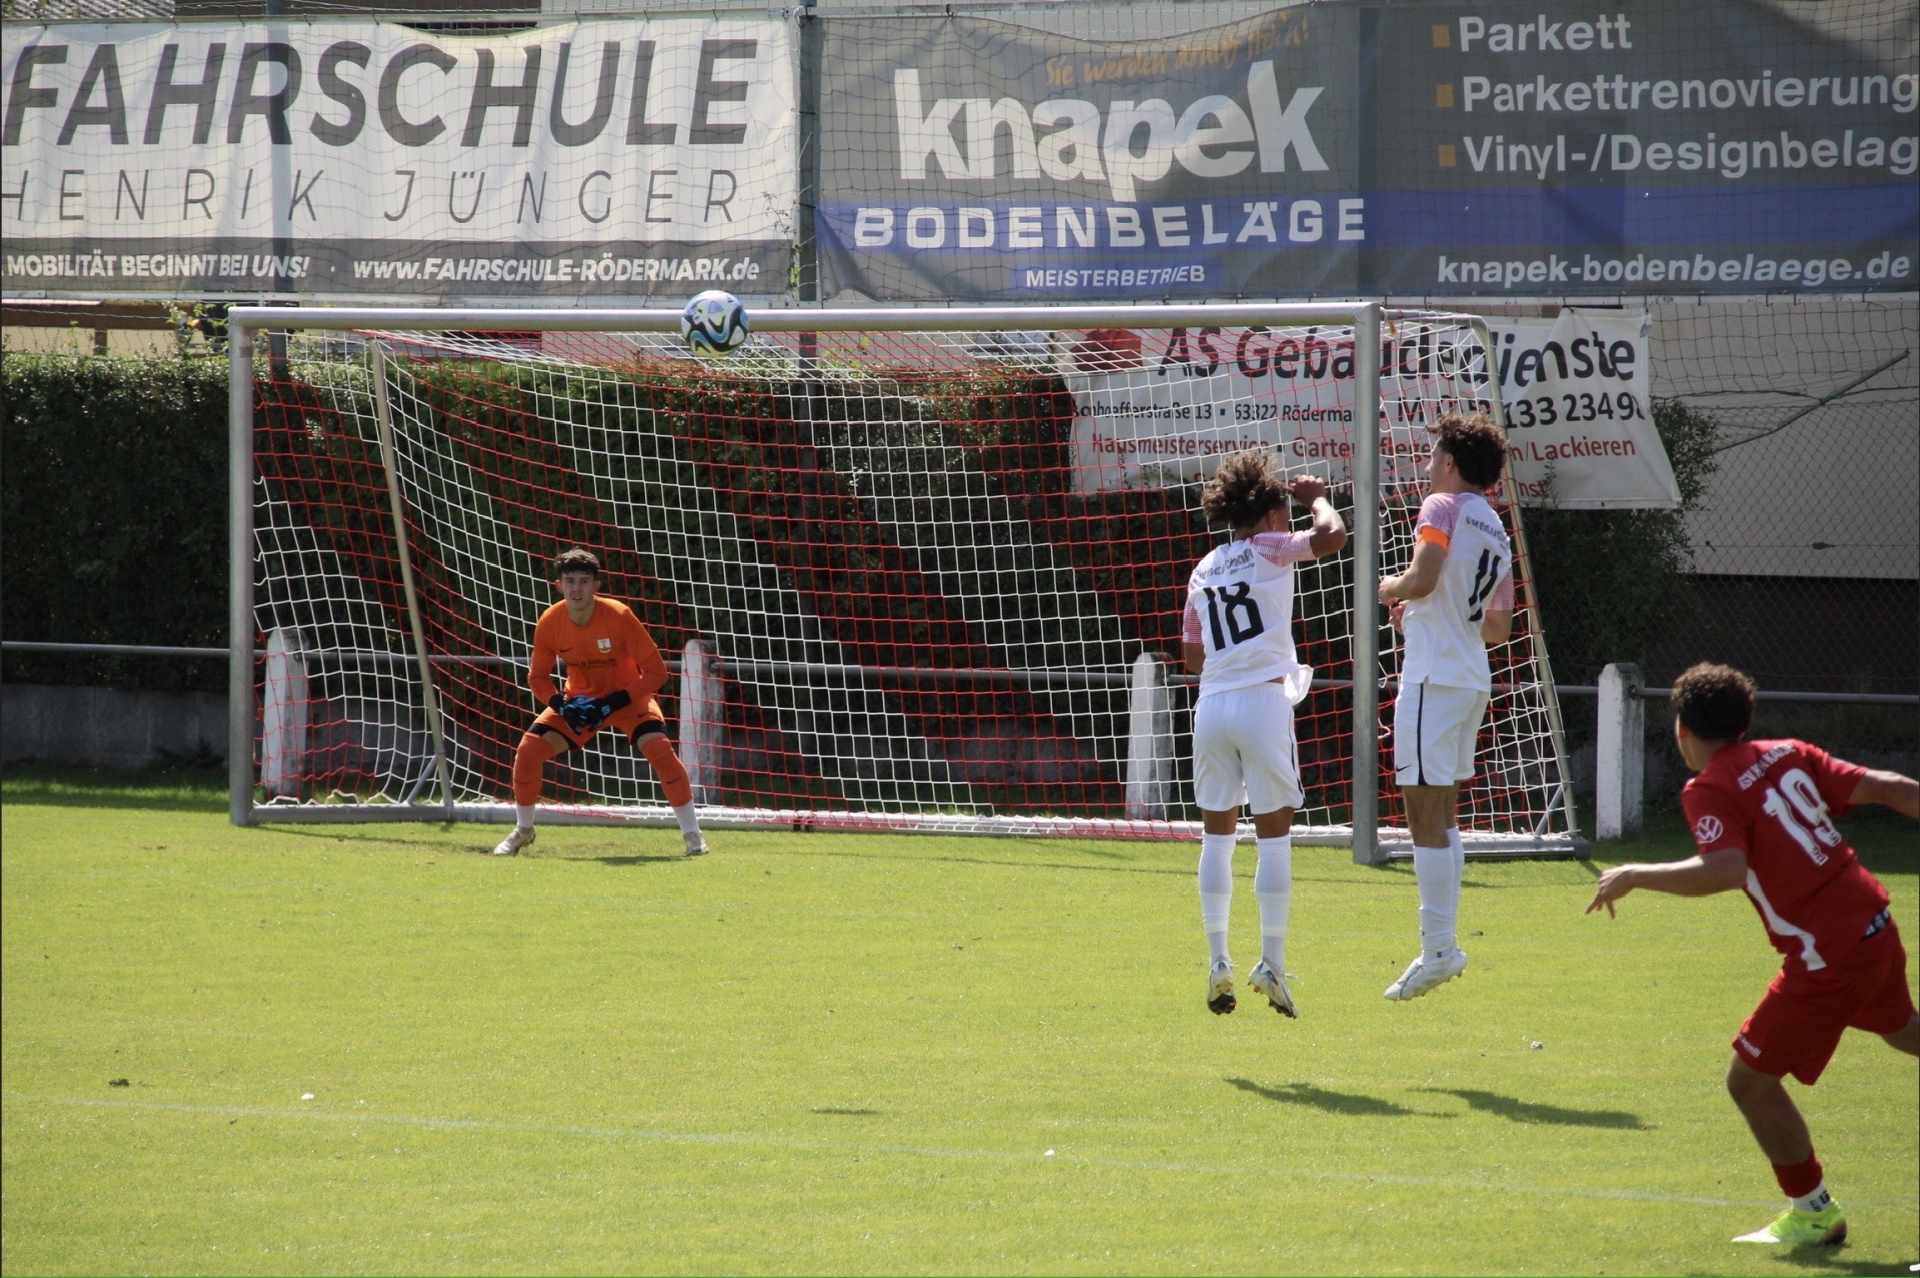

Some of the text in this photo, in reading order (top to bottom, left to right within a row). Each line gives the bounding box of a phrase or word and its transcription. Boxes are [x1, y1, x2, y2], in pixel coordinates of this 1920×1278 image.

[1459, 14, 1632, 52] Parkett
[1045, 54, 1075, 86] Sie
[1083, 50, 1167, 84] werden
[2, 39, 758, 148] FAHRSCHULE
[1463, 70, 1920, 113] Parkettrenovierung
[894, 59, 1329, 203] knapek
[1463, 130, 1920, 180] Vinyl-/Designbelag
[2, 168, 738, 224] HENRIK JÜNGER
[855, 198, 1366, 248] BODENBELÄGE
[7, 248, 310, 278] MOBILITÄT BEGINNT BEI UNS!
[353, 253, 760, 282] www.FAHRSCHULE-RÖDERMARK.de
[1026, 265, 1206, 289] MEISTERBETRIEB
[1438, 252, 1910, 289] knapek-bodenbelaege.de
[1157, 326, 1222, 378] AS
[1196, 403, 1213, 420] 13
[1282, 404, 1356, 423] Röderma
[1509, 435, 1636, 462] n/Lackieren
[1203, 581, 1265, 652] 18
